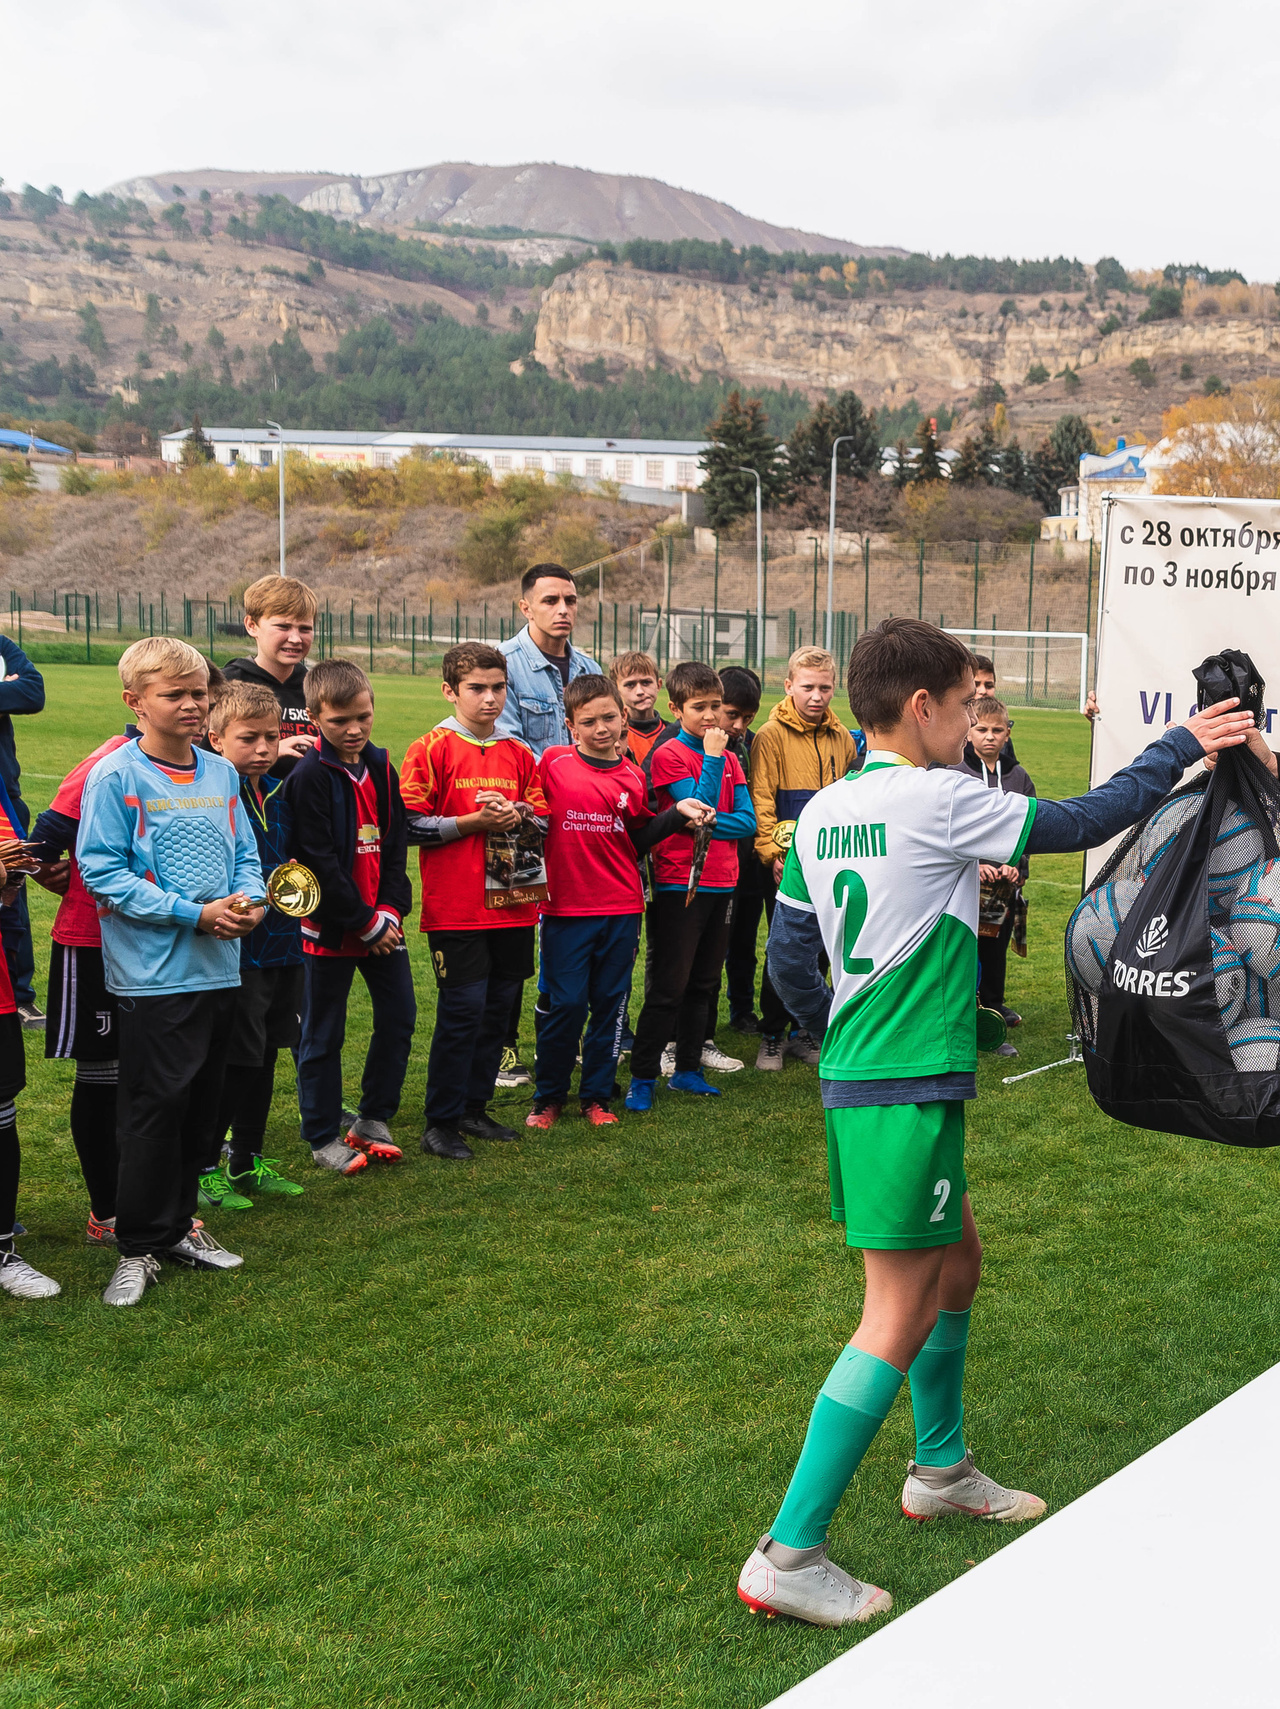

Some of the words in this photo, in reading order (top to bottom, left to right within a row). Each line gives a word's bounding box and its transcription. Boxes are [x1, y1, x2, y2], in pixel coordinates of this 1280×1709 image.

[1120, 525, 1134, 544] с
[1142, 520, 1172, 546] 28
[1124, 565, 1155, 586] по
[1163, 561, 1177, 587] 3
[1185, 562, 1277, 596] ноября
[1139, 691, 1172, 725] VI
[455, 777, 517, 790] КИСЛОВОДСК
[145, 796, 225, 813] КИСЛОВОДСК
[566, 809, 613, 822] Standard
[562, 820, 612, 833] Chartered
[816, 822, 888, 861] ОЛИМП
[833, 869, 875, 975] 2
[929, 1178, 951, 1223] 2
